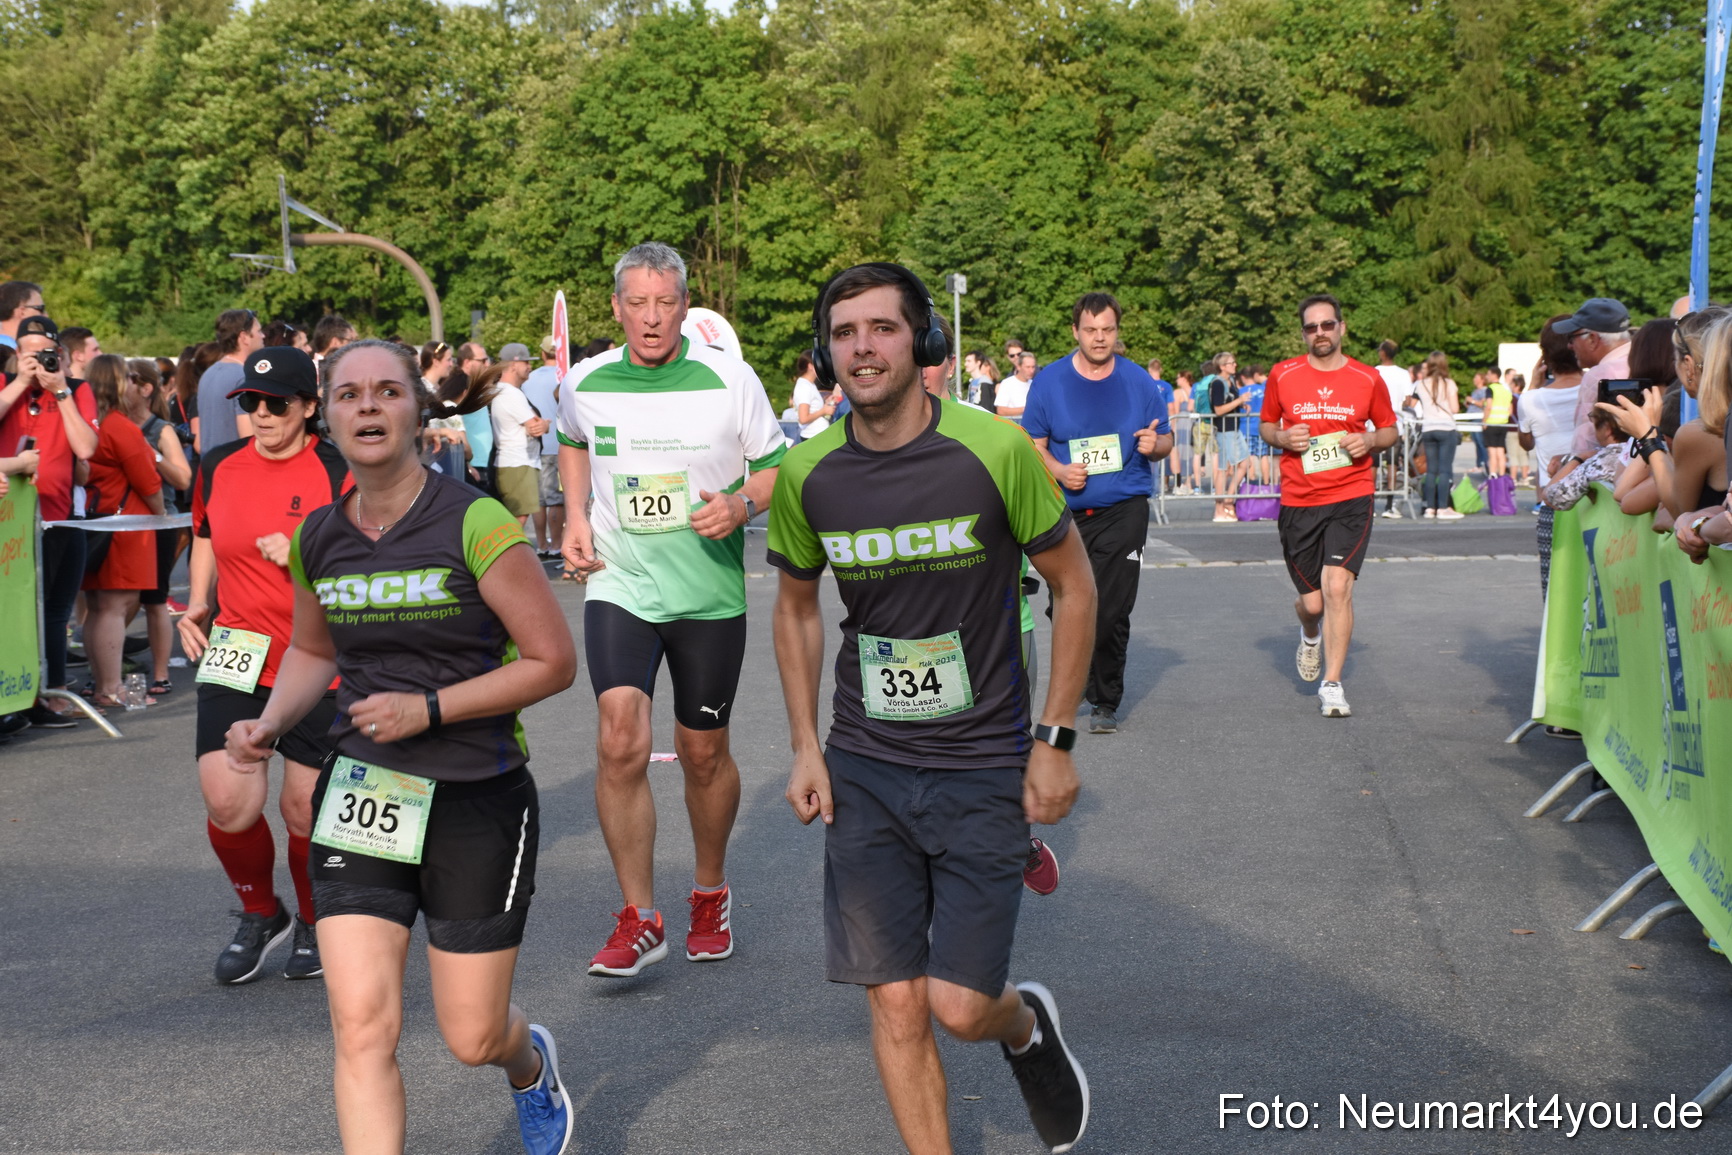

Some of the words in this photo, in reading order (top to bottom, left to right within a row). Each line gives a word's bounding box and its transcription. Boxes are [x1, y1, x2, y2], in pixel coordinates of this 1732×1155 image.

[1293, 402, 1317, 414] Echtes
[1318, 402, 1355, 416] Handwerk
[1323, 413, 1347, 421] FRISCH
[595, 436, 616, 446] BayWa
[1082, 449, 1110, 465] 874
[1312, 446, 1338, 462] 591
[629, 495, 672, 517] 120
[819, 517, 981, 566] BOCK
[869, 568, 885, 580] by
[889, 562, 926, 576] smart
[929, 553, 987, 572] concepts
[314, 571, 453, 607] BOCK
[346, 612, 359, 625] by
[361, 611, 396, 623] smart
[398, 605, 462, 623] concepts
[205, 646, 252, 673] 2328
[935, 654, 957, 666] 2019
[880, 667, 943, 699] 334
[887, 698, 911, 707] Vörös
[912, 697, 942, 707] Laszlo
[338, 792, 401, 834] 305
[401, 798, 424, 808] 2019
[333, 823, 364, 838] Horvath
[366, 831, 398, 845] Monika
